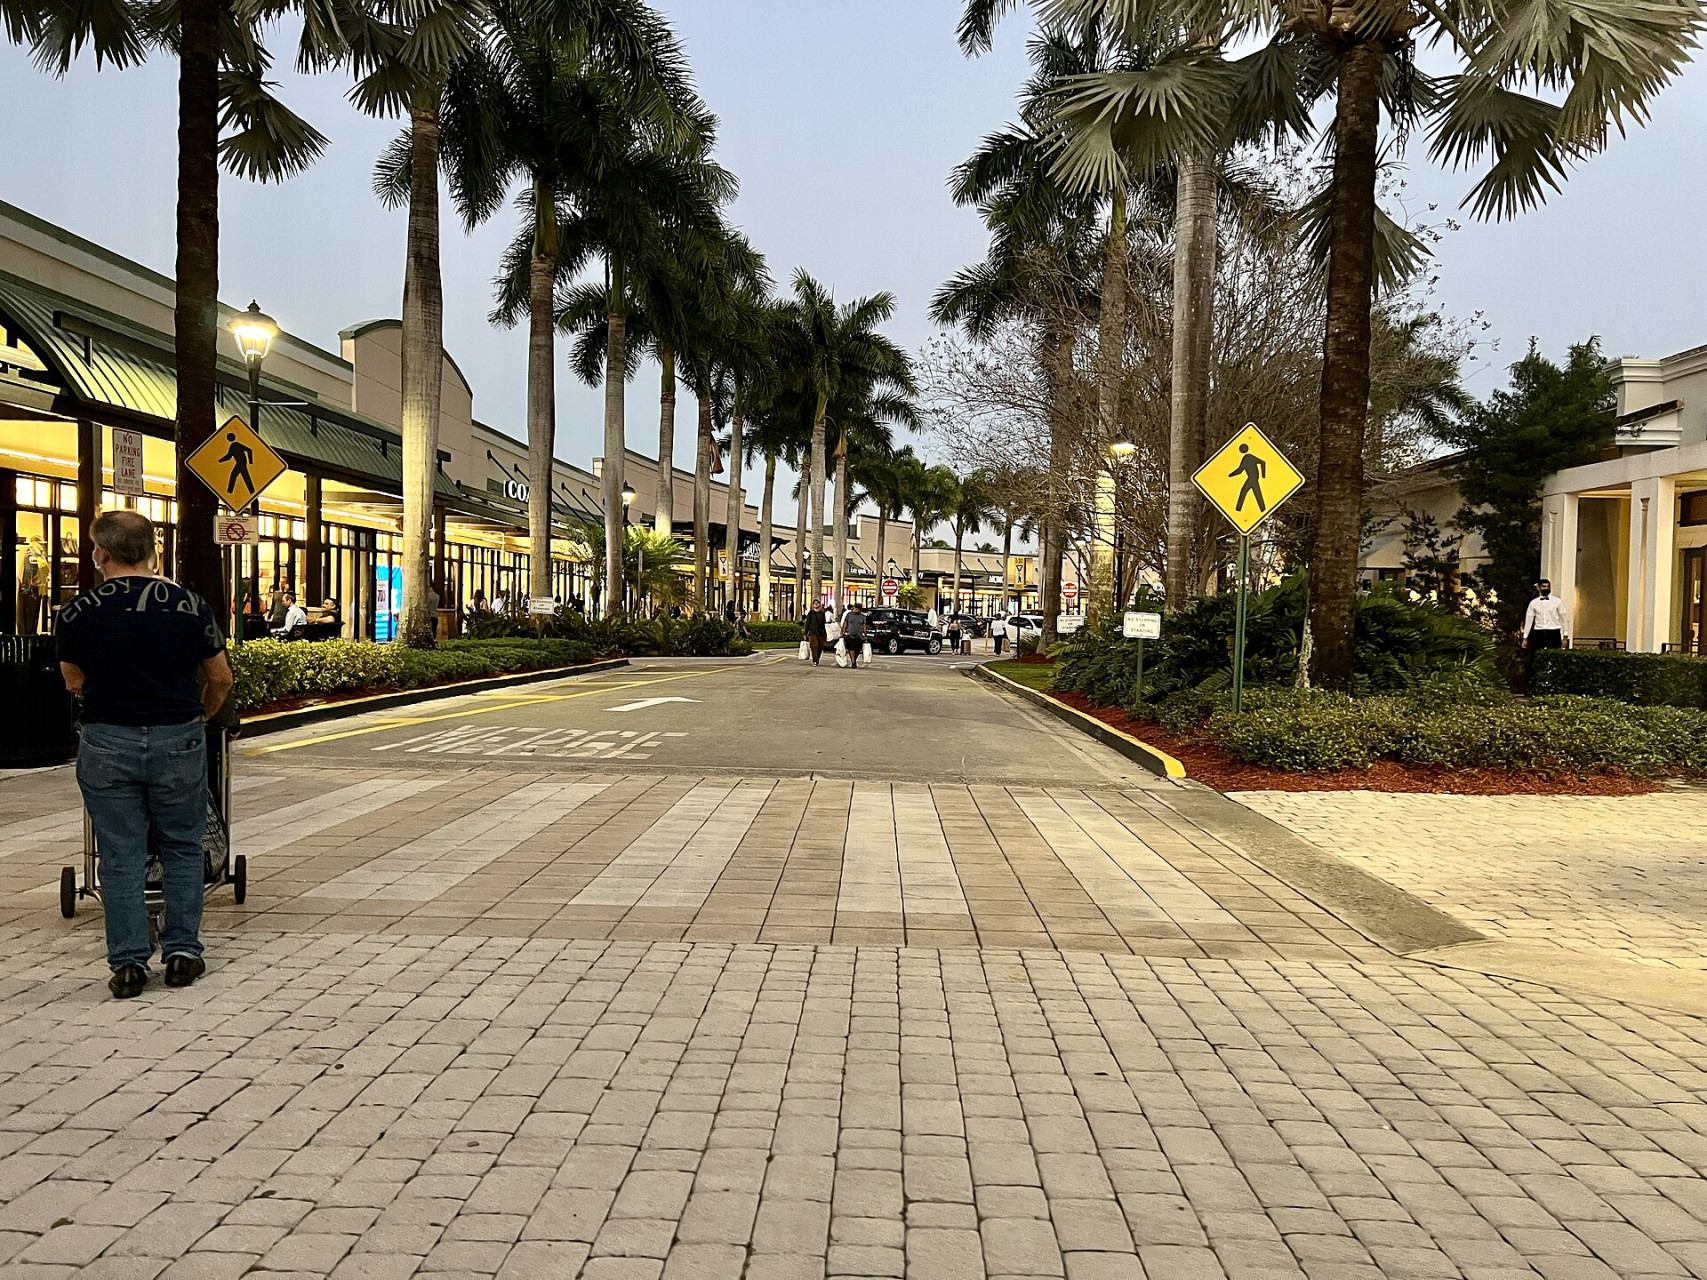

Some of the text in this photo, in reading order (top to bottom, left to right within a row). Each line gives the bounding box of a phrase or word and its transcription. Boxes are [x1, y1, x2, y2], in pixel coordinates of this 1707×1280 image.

[122, 433, 133, 444] NO
[116, 444, 140, 457] PARKING
[122, 456, 134, 468] FIRE
[122, 468, 136, 478] LANE
